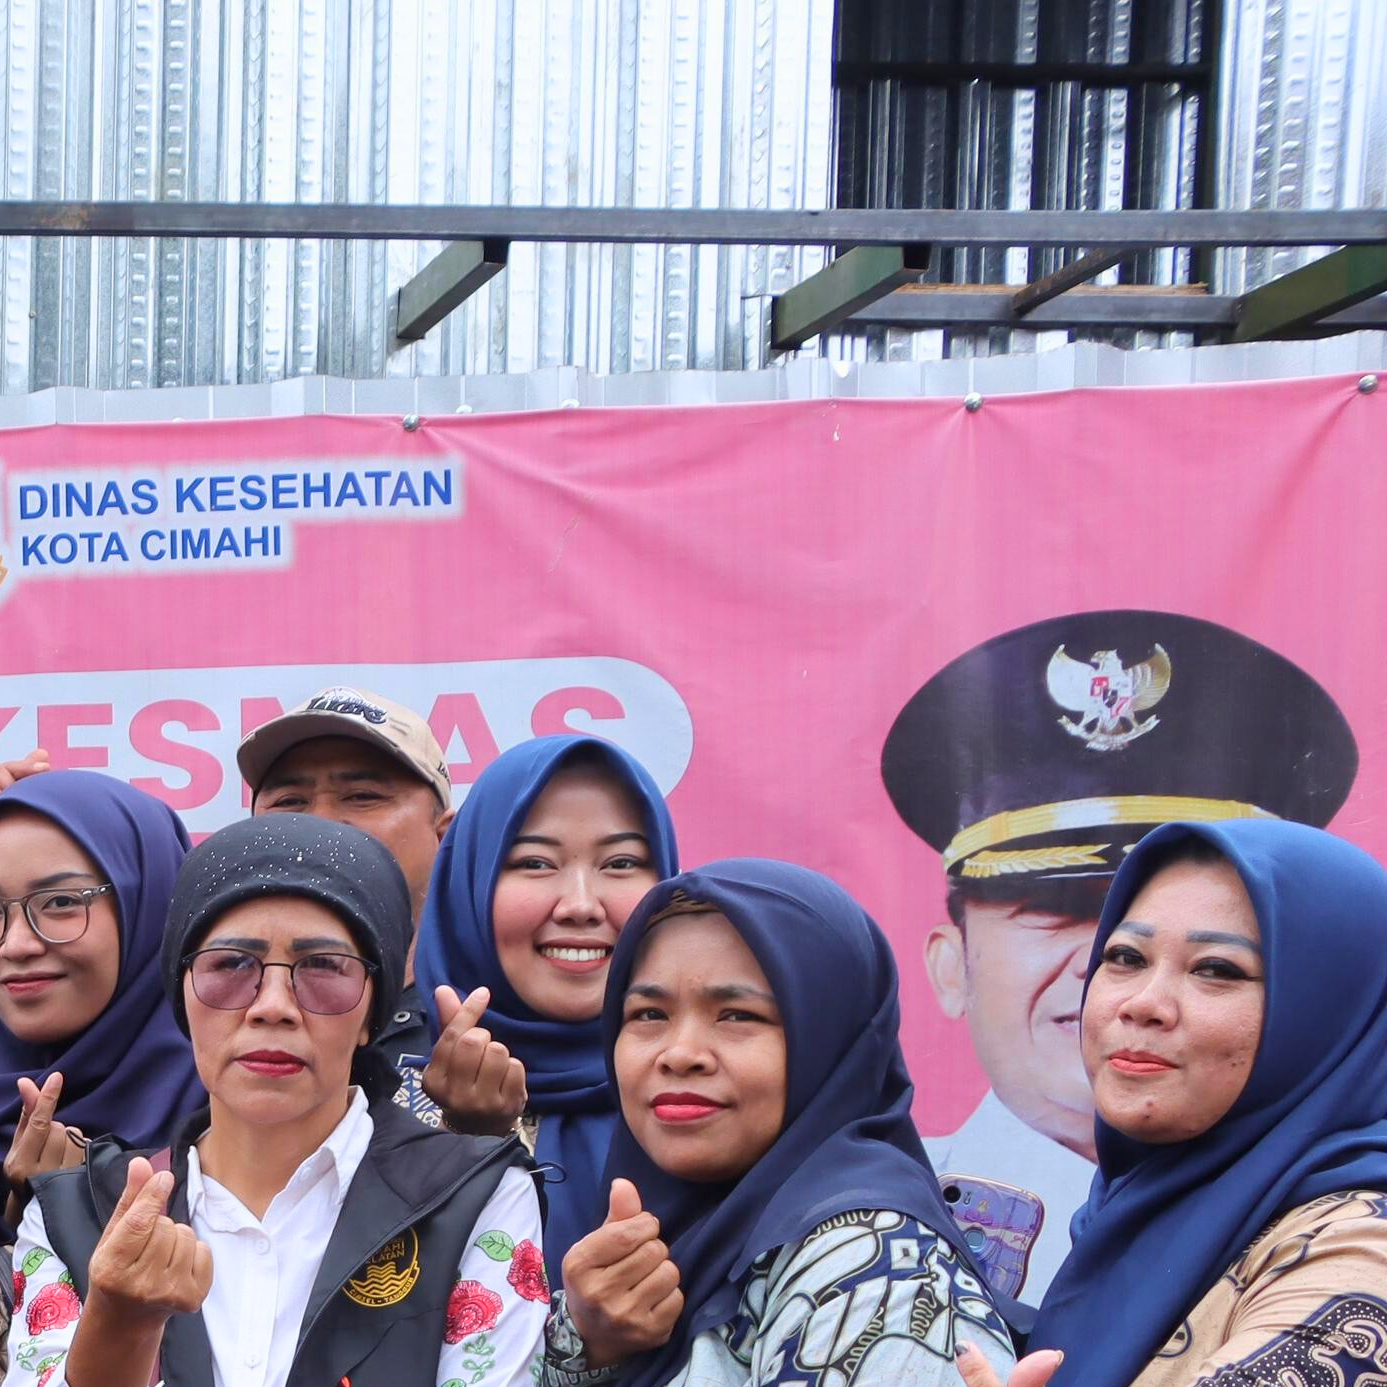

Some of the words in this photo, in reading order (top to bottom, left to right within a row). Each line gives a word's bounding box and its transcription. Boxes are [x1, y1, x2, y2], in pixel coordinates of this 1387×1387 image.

[19, 479, 159, 520] DINAS
[175, 469, 453, 513] KESEHATAN
[22, 532, 130, 566] KOTA
[140, 525, 282, 561] CIMAHI
